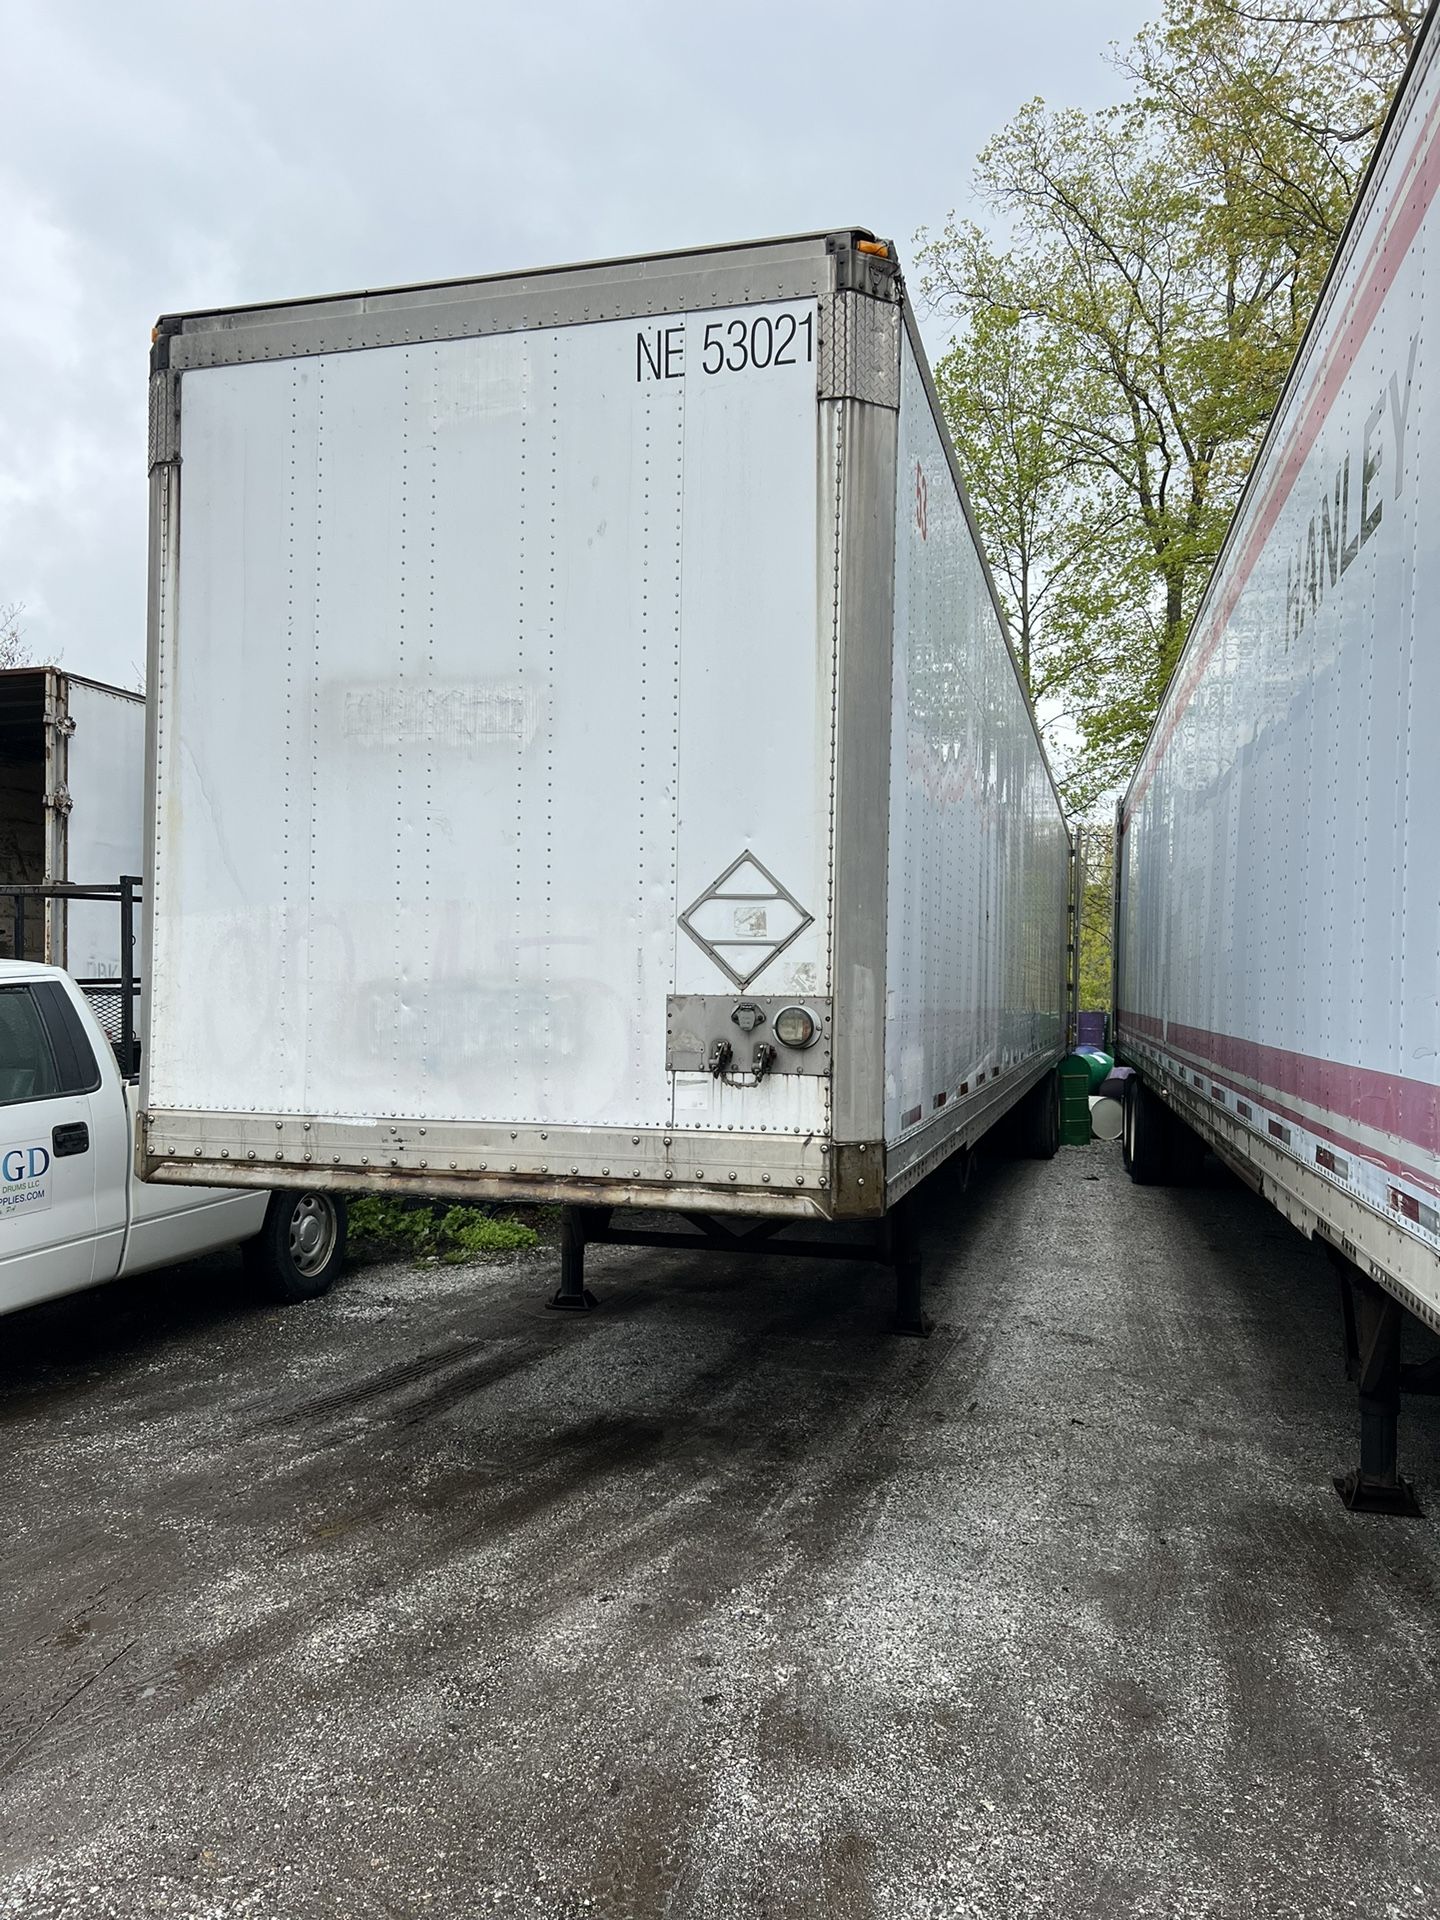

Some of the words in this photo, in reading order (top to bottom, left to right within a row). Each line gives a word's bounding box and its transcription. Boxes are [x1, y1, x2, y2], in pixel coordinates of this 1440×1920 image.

[636, 327, 686, 382] NE
[702, 311, 813, 375] 53021
[2, 1147, 50, 1182] GD
[2, 1183, 27, 1194] DRUMS
[27, 1180, 40, 1189] LLC
